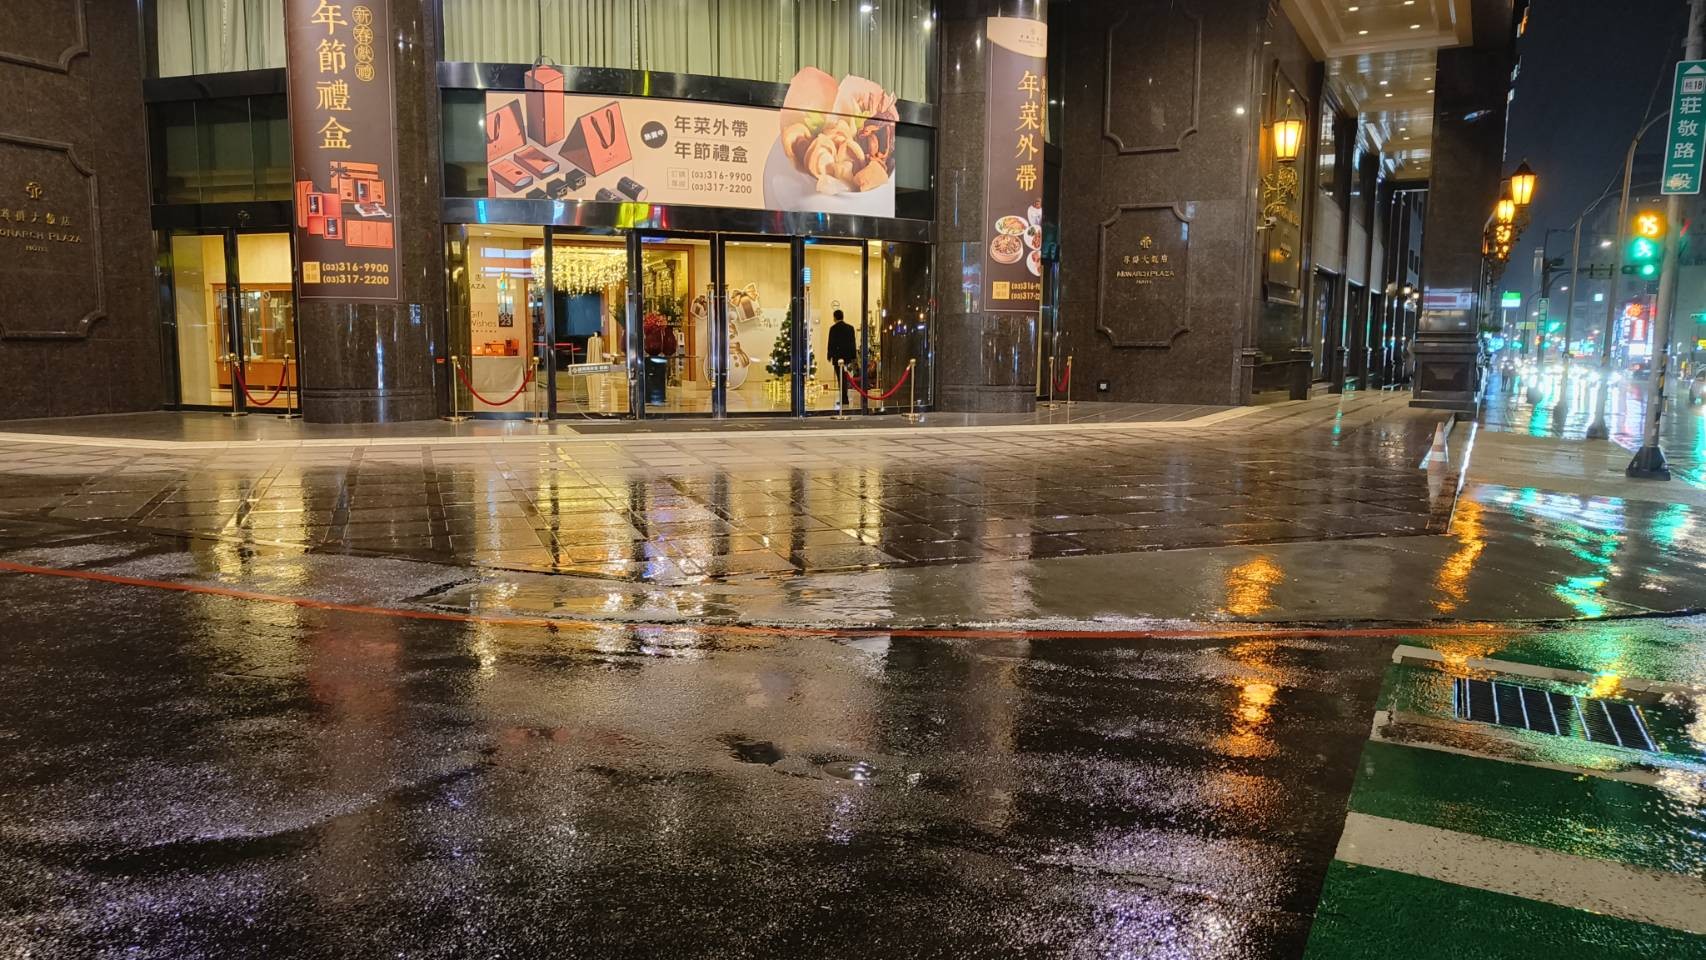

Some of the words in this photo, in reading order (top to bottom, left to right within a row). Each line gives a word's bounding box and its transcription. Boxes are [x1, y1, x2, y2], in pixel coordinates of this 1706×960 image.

[310, 0, 353, 150] 年節禮盒
[673, 114, 749, 138] 年菜外帶
[1015, 69, 1041, 192] 年菜外帶
[673, 140, 749, 164] 年節禮盒
[1669, 96, 1703, 190] 莊敬路一段
[691, 170, 752, 182] (03)316-9900
[691, 182, 752, 194] (03)317-2200
[48, 232, 81, 243] PLAZA
[322, 262, 389, 273] (03)316-9900
[322, 274, 389, 285] (03)317-2200
